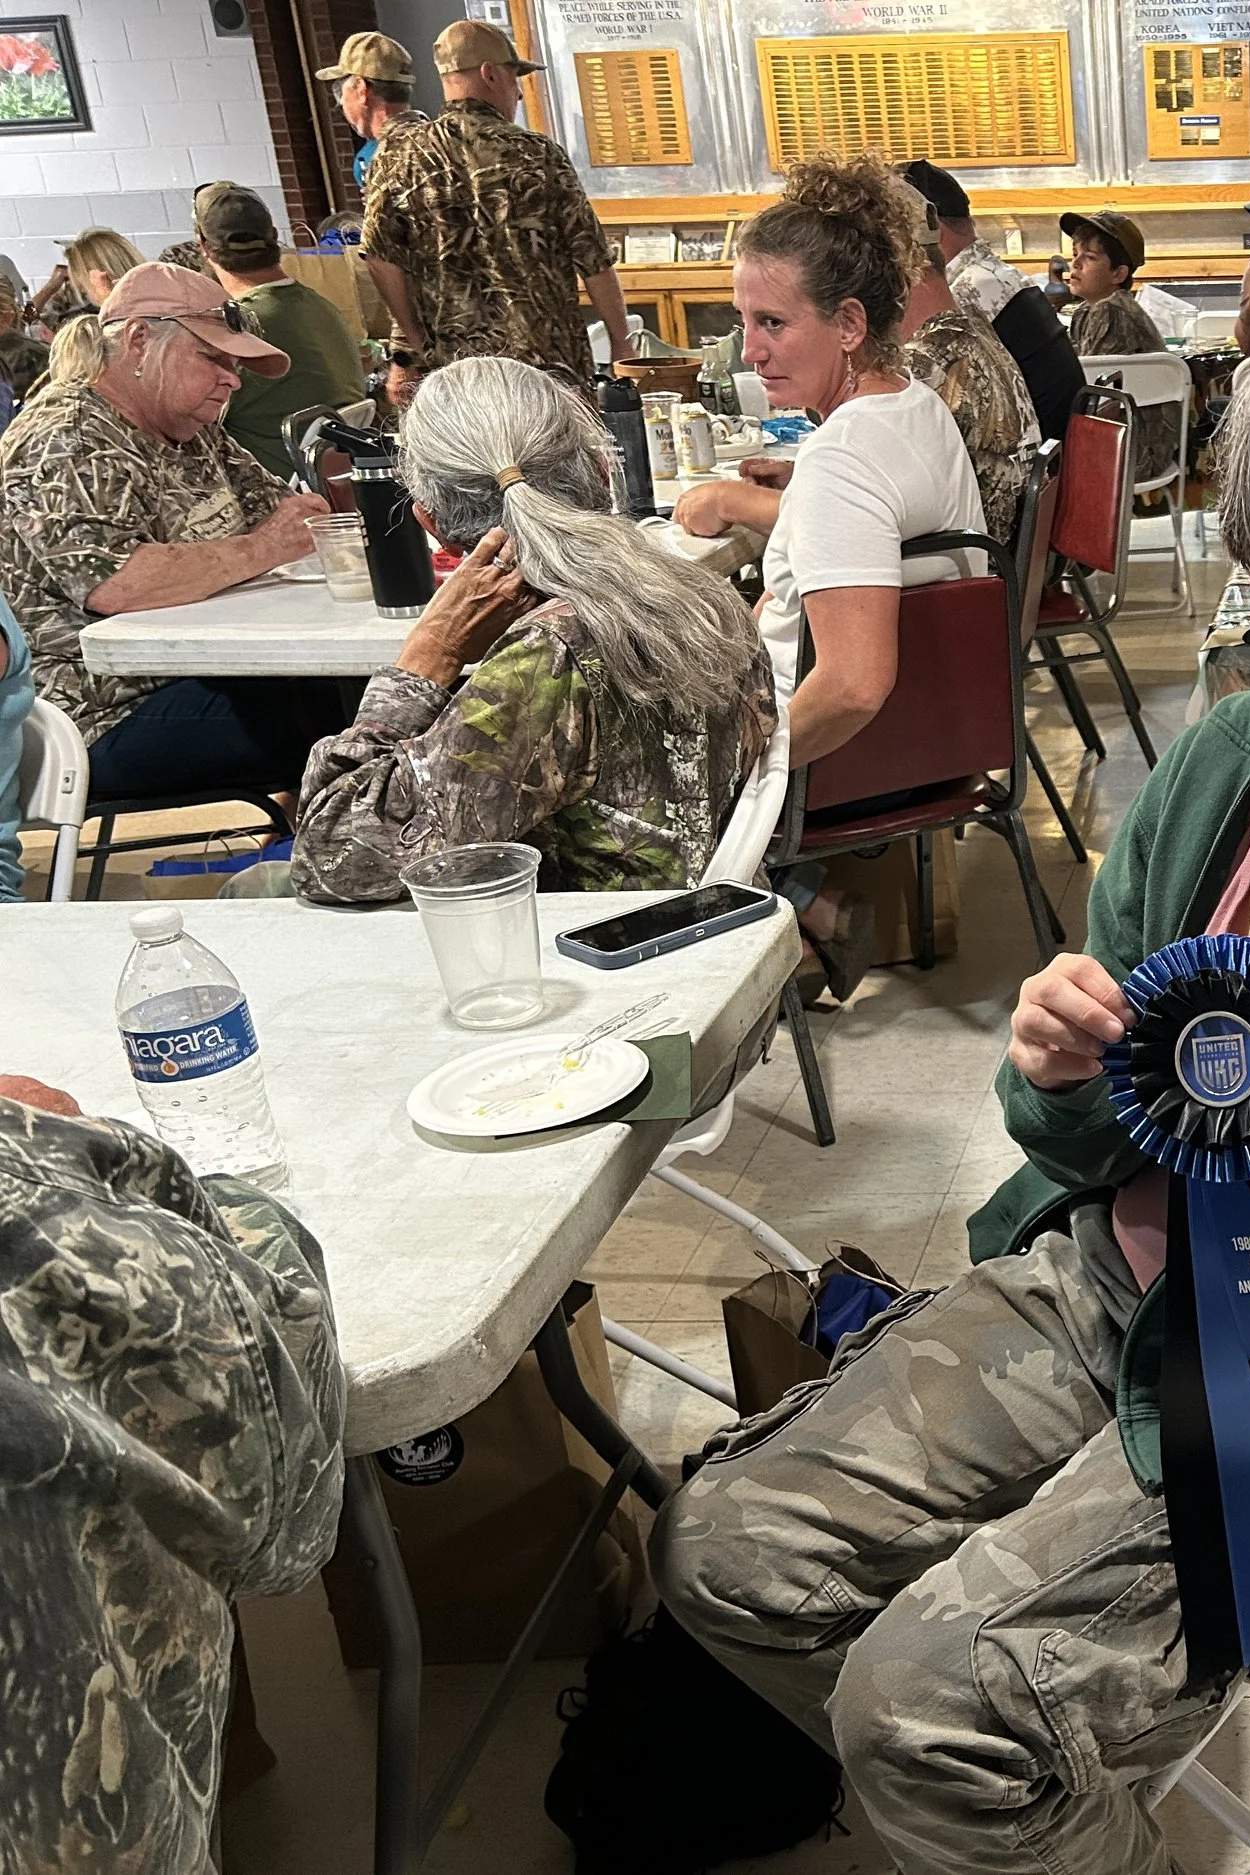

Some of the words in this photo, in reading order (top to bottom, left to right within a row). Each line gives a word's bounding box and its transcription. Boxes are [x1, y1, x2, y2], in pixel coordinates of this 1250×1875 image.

[617, 1, 652, 11] SERVING
[655, 1, 663, 9] IN
[861, 6, 904, 18] WORLD
[908, 5, 935, 16] WAR
[939, 4, 948, 15] II
[1135, 8, 1170, 17] UNITED
[1172, 6, 1213, 16] NATIONS
[594, 12, 624, 22] FORCES
[627, 12, 637, 21] OF
[640, 11, 656, 20] THE
[595, 25, 623, 34] WORLD
[627, 24, 647, 34] WAR
[1140, 24, 1181, 34] KOREA
[124, 1025, 226, 1076] niagara
[1199, 1041, 1239, 1054] UNITED
[180, 1054, 215, 1069] DRINKING
[1201, 1058, 1241, 1089] UKC
